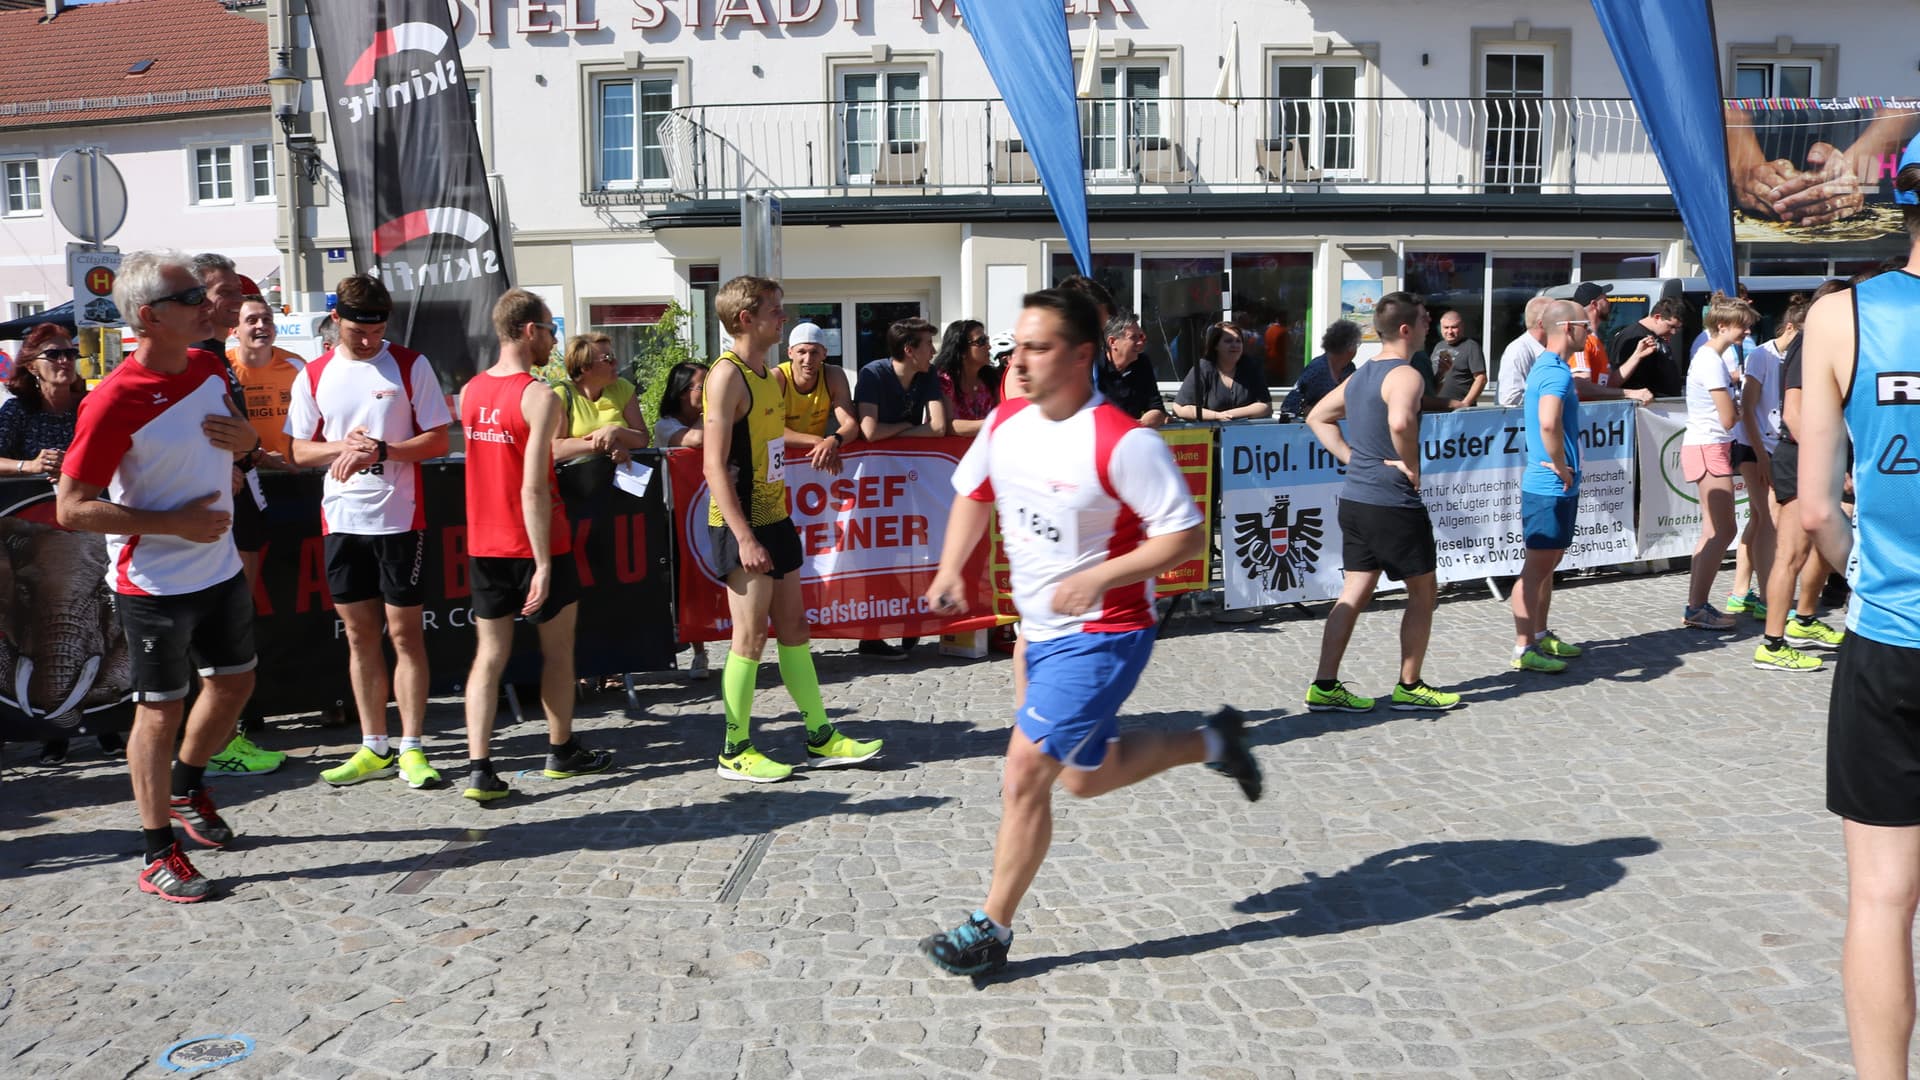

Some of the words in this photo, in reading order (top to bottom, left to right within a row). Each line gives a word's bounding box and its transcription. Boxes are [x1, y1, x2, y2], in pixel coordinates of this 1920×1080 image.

[1233, 442, 1298, 481] Dipl.
[1452, 479, 1520, 495] Kulturtechnik
[1446, 499, 1490, 513] befugter
[1493, 495, 1515, 507] und
[1438, 515, 1490, 530] Allgemein
[797, 515, 929, 557] EINER
[1435, 535, 1495, 552] ieselburg
[1612, 521, 1623, 533] 13
[1464, 553, 1486, 565] Fax
[1489, 550, 1509, 564] DW
